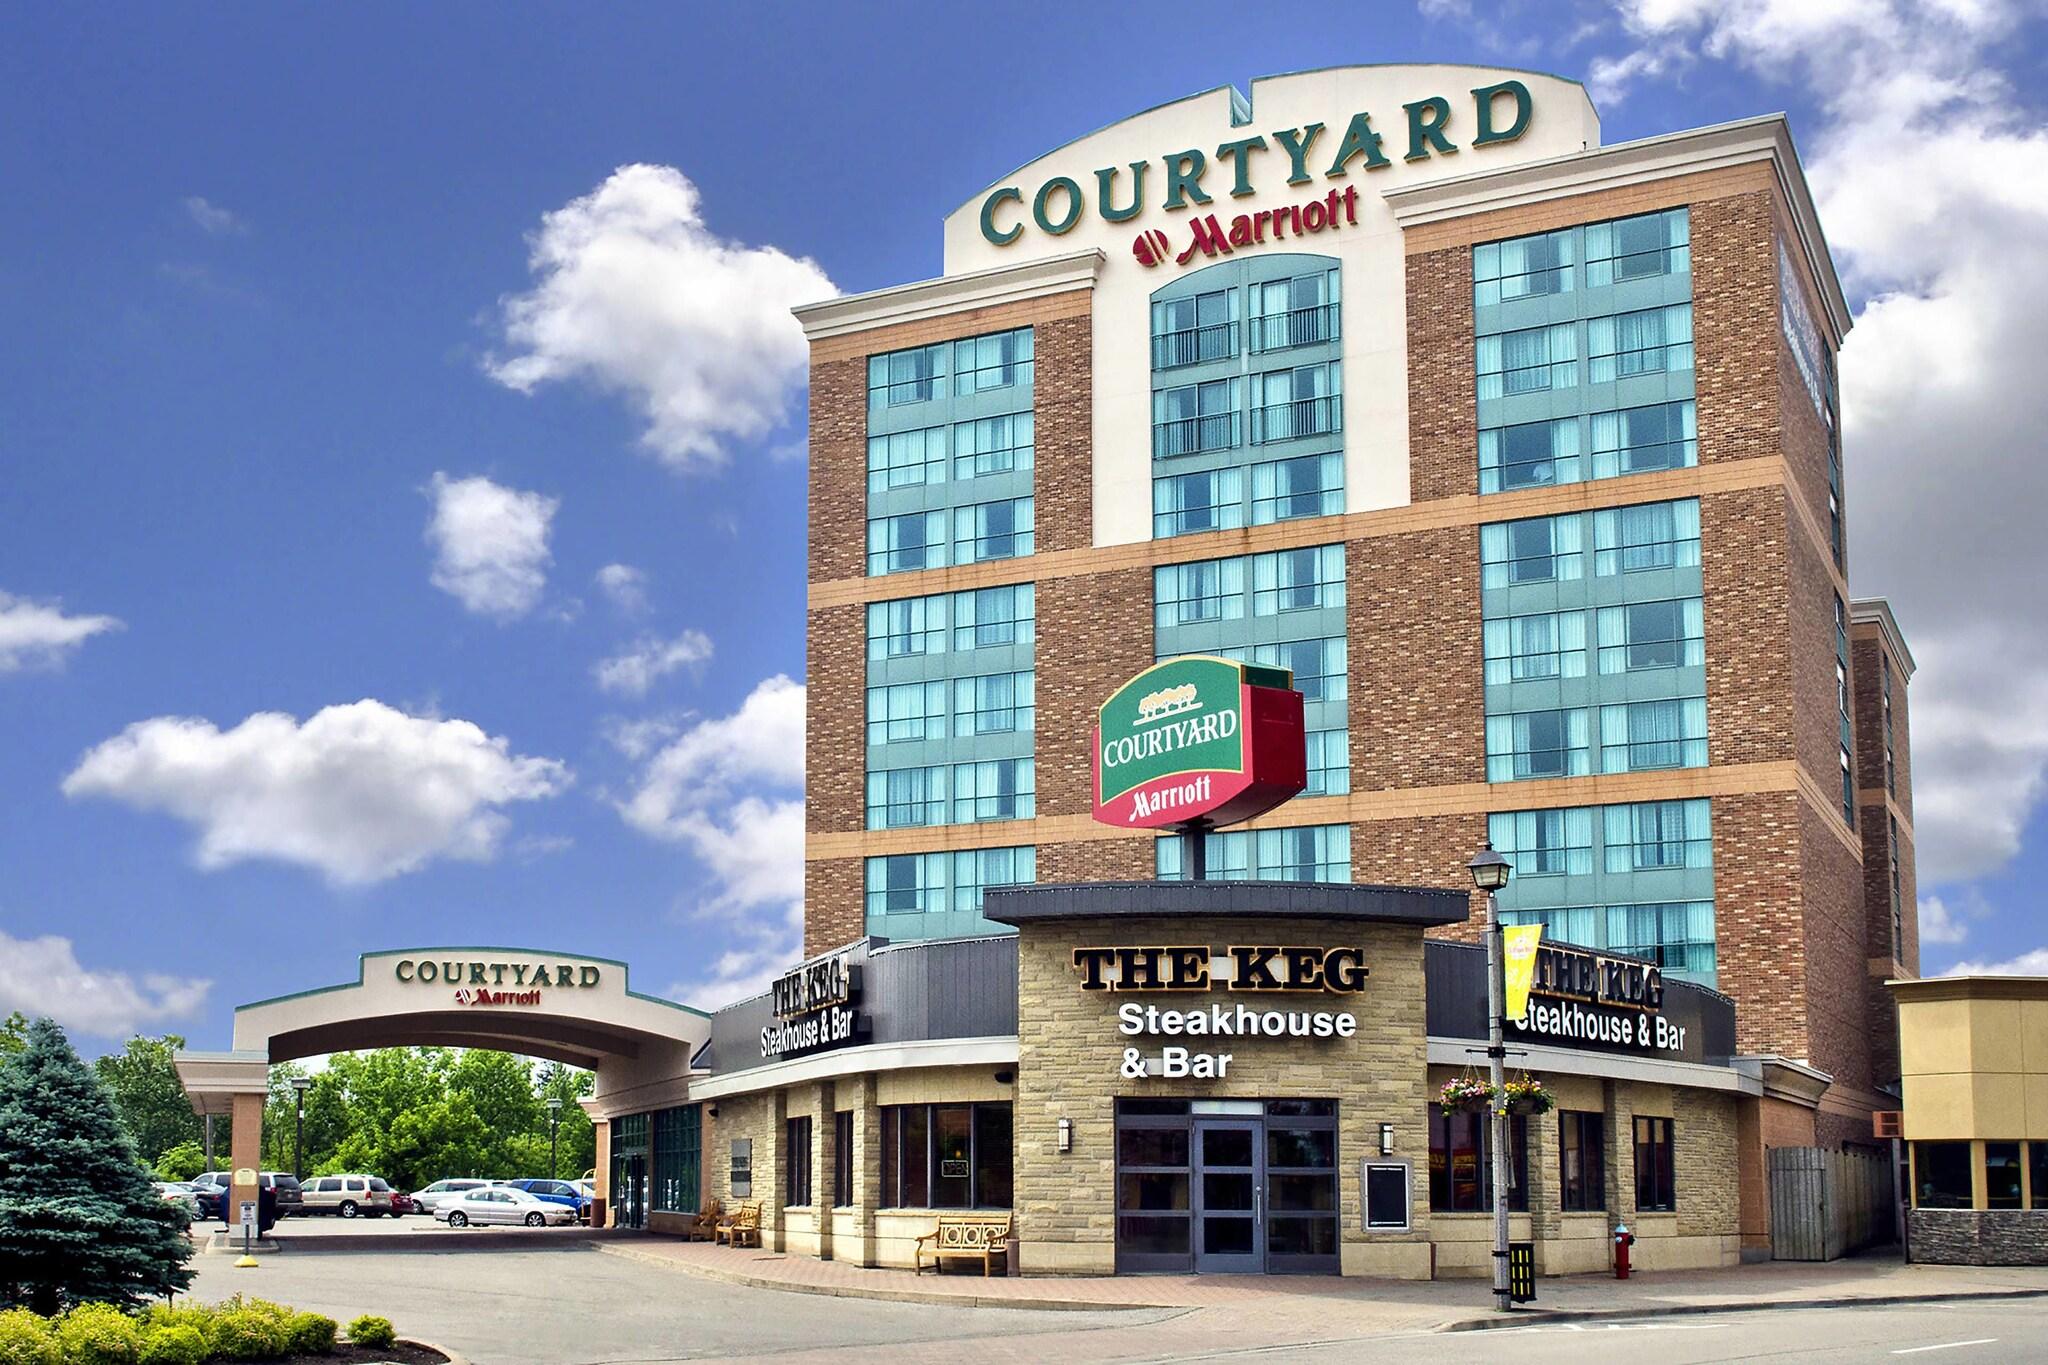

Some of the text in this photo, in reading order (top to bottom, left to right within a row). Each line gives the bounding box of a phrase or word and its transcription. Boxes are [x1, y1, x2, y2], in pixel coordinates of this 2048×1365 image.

[979, 80, 1534, 246] COURTYARD
[1175, 184, 1359, 265] Marriott
[1103, 709, 1237, 768] COURTYARD
[1128, 774, 1212, 822] Marriott
[395, 960, 601, 988] COURTYARD
[772, 956, 849, 1018] THE KEG
[1073, 946, 1369, 993] THE KEG
[1597, 957, 1663, 1012] KEG
[471, 988, 541, 1006] Marriott
[1118, 1003, 1357, 1037] Steakhouse
[760, 1006, 853, 1058] Steakhouse & Bar
[1637, 1013, 1651, 1047] &
[1655, 1016, 1686, 1051] Bar
[1120, 1047, 1233, 1079] & Bar
